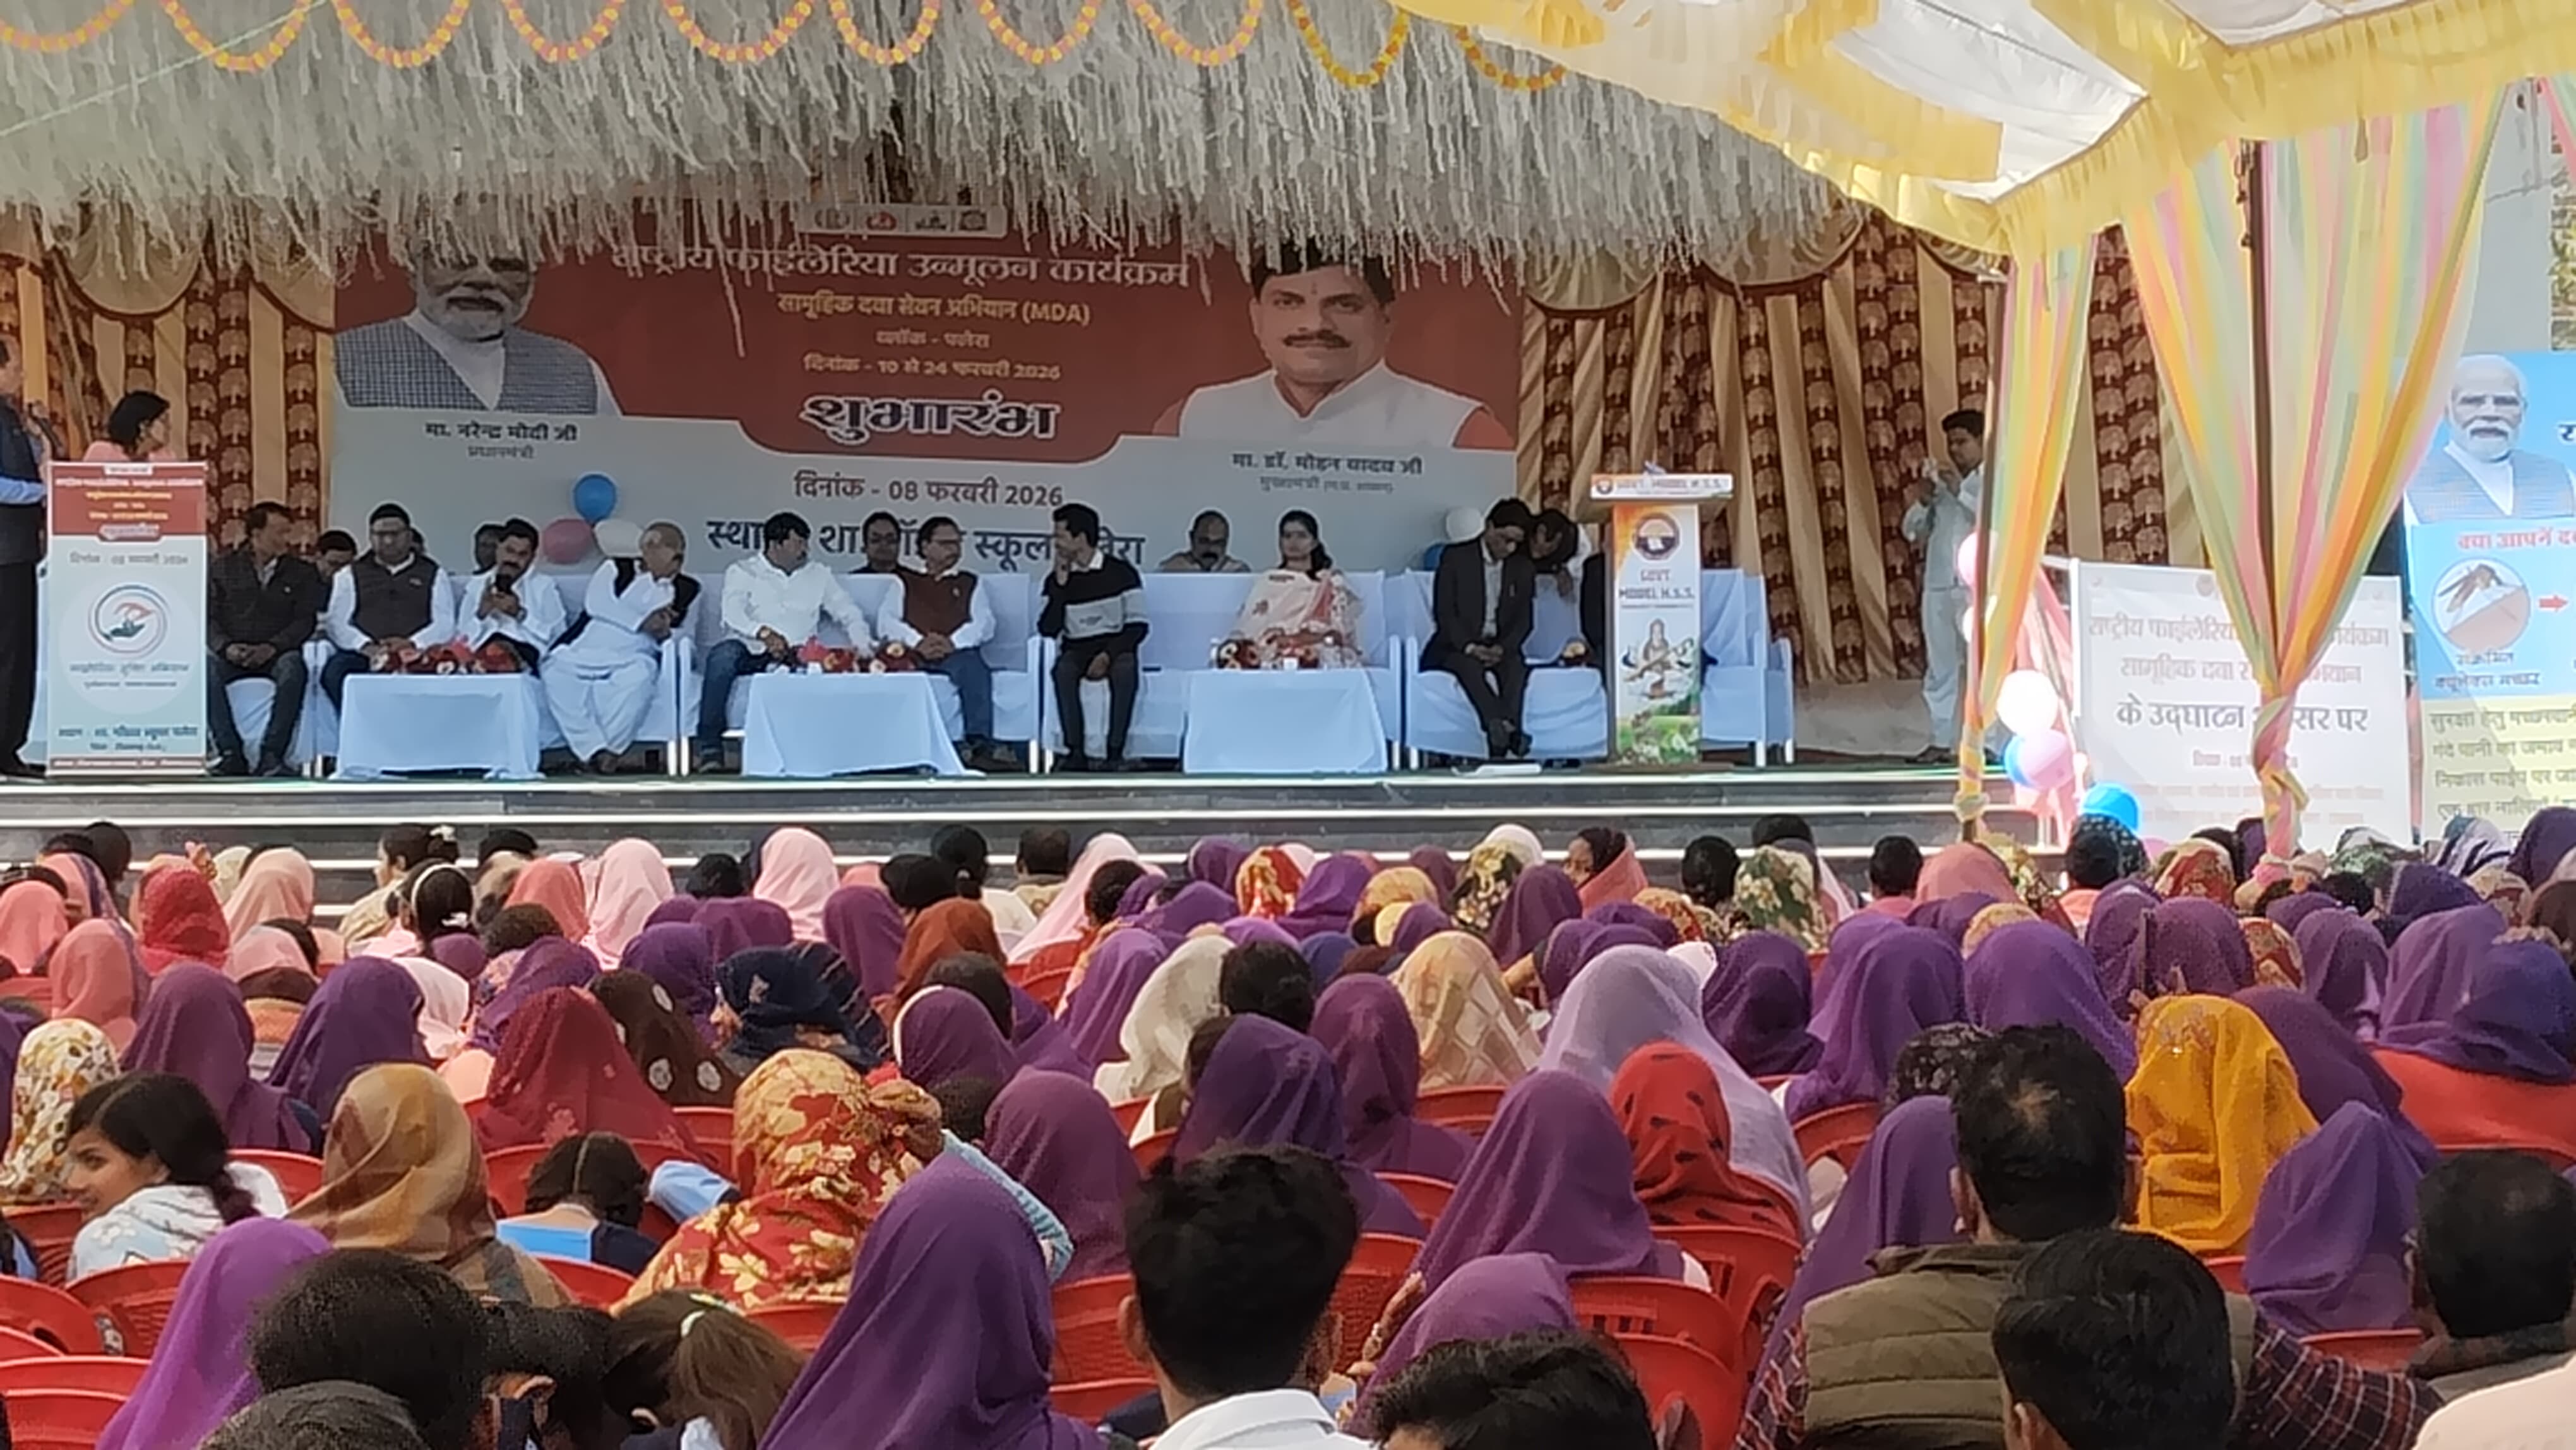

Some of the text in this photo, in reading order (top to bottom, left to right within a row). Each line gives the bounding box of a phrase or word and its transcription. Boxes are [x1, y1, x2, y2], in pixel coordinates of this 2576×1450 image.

[907, 254, 1041, 287] उन्मूलन
[1048, 254, 1190, 287] कार्यक्रम
[777, 289, 1090, 326] सामूहिक दवा सेवन अभियान (MDA)
[803, 352, 861, 372] दिनांक
[878, 361, 899, 374] 10
[924, 361, 947, 375] 24
[952, 359, 1010, 377] फरवरी
[1013, 364, 1061, 379] 2026
[507, 422, 549, 441] मोदी
[799, 388, 1061, 443] शुभारंभ
[1295, 452, 1342, 472] मोहन
[794, 469, 866, 498] दिनांक
[889, 481, 919, 500] 08
[925, 476, 999, 503] फरवरी
[1005, 485, 1063, 506] 2026
[707, 520, 765, 550] स्था
[2147, 614, 2236, 643] फाईलेरिय
[2121, 652, 2195, 685] सामूहिक
[2201, 661, 2234, 680] दवा
[2116, 693, 2142, 725] के
[2336, 709, 2368, 731] पर
